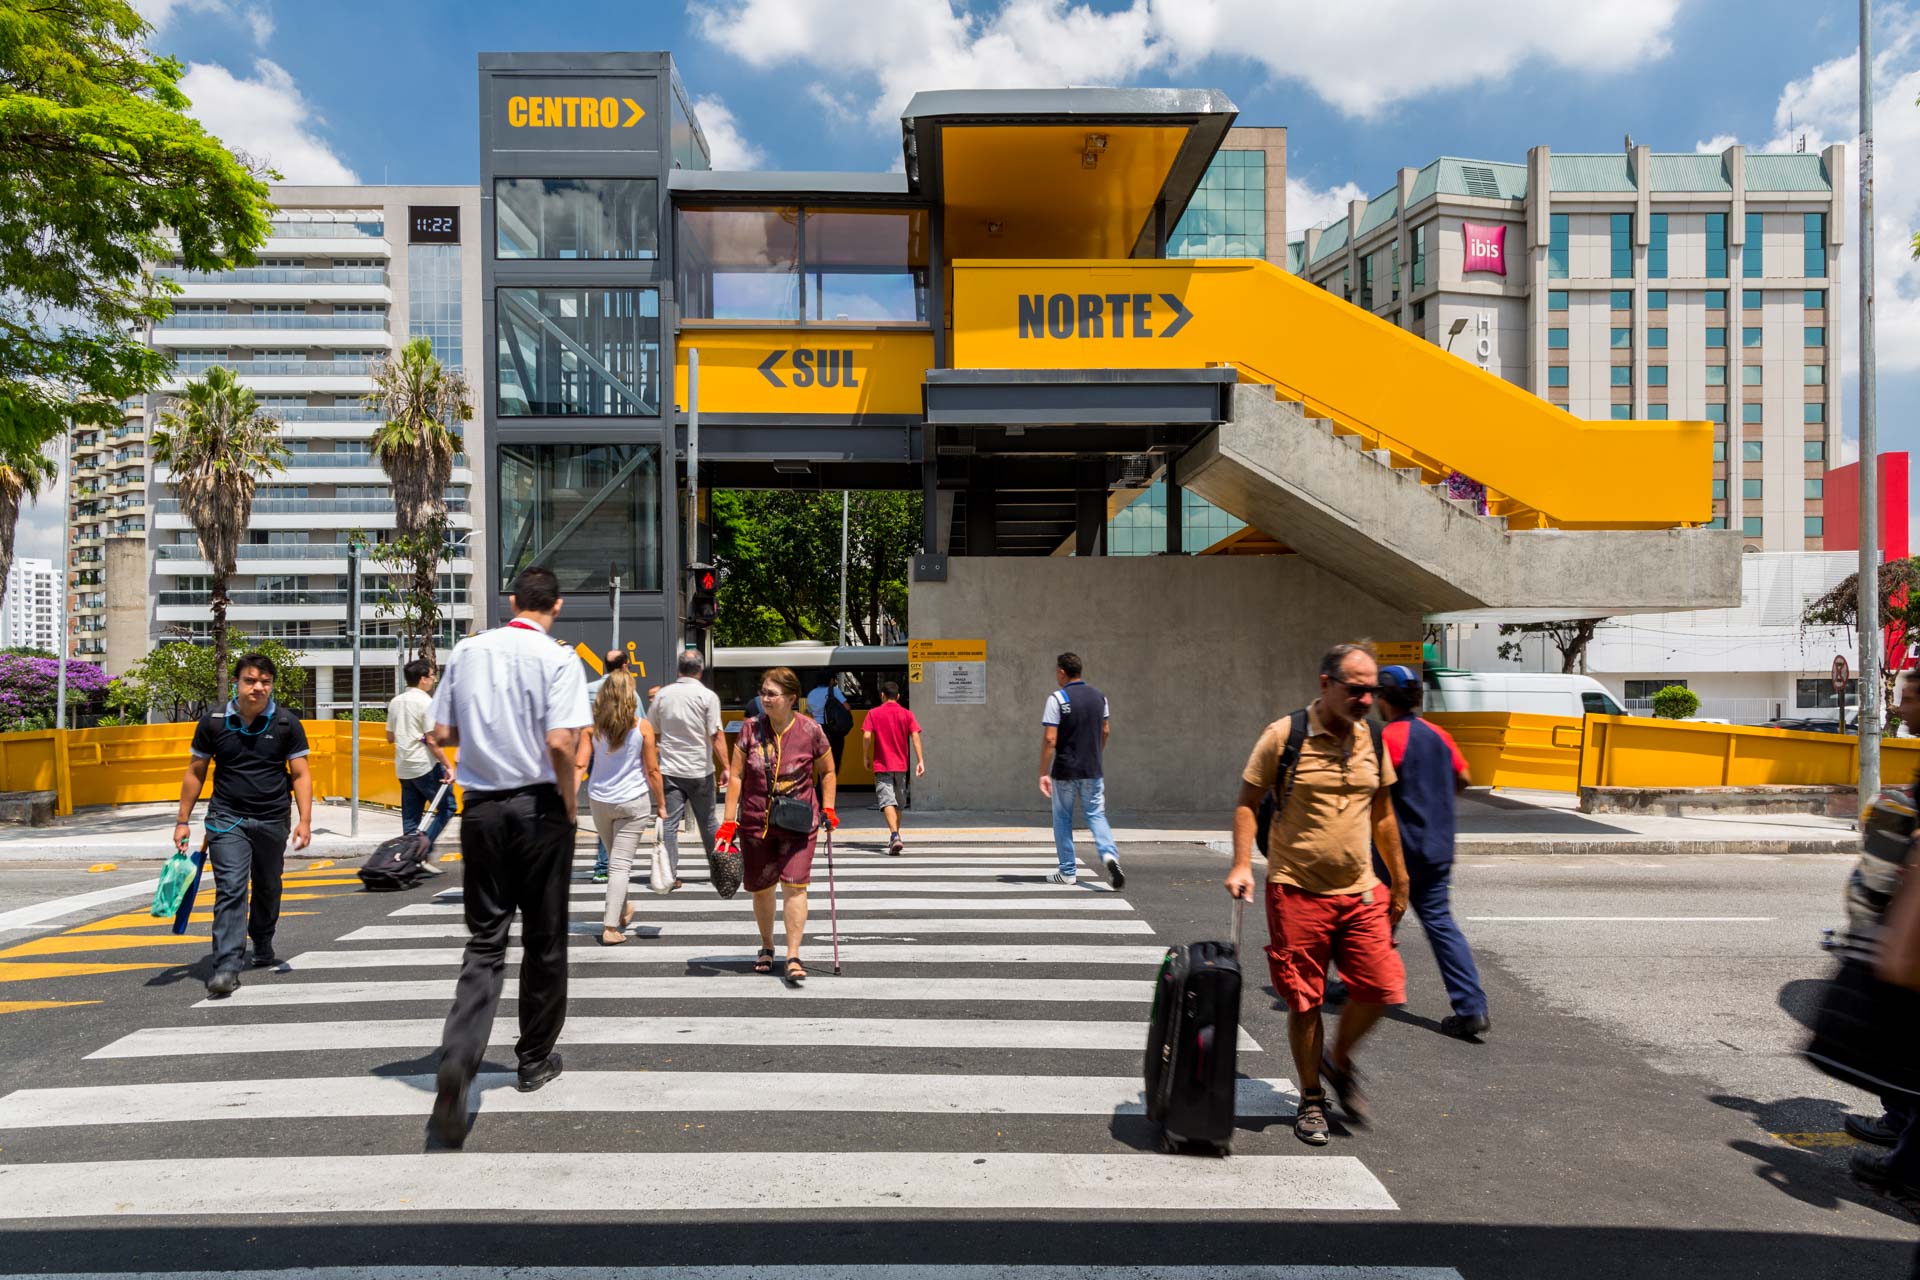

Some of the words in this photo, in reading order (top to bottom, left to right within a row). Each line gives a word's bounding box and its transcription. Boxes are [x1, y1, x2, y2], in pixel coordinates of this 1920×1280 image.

[508, 95, 619, 129] CENTRO
[417, 217, 453, 232] 11:22
[1471, 238, 1499, 258] ibis
[1018, 293, 1153, 340] NORTE
[792, 348, 859, 388] SUL
